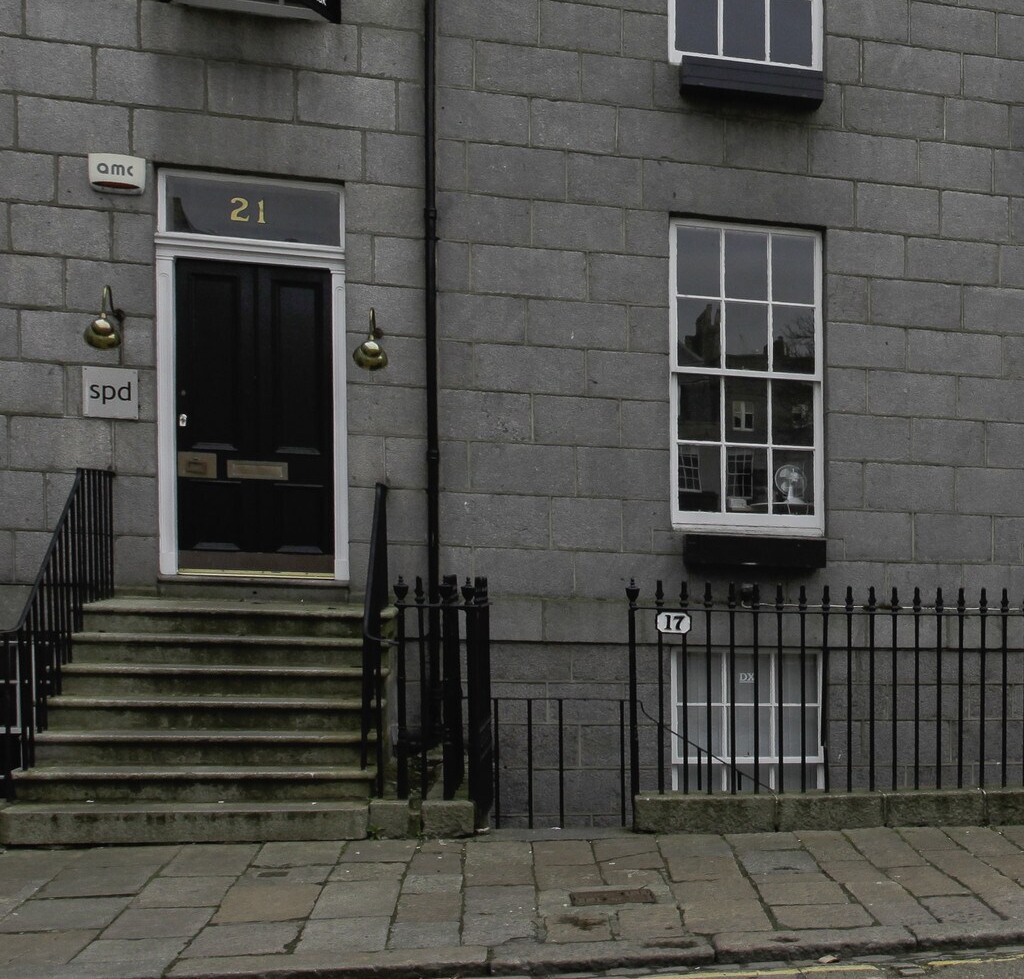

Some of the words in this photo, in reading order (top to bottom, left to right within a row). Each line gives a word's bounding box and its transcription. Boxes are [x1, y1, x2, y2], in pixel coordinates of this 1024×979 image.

[96, 162, 133, 177] amc
[230, 197, 266, 224] 21
[89, 381, 132, 405] spd
[663, 614, 686, 631] 17
